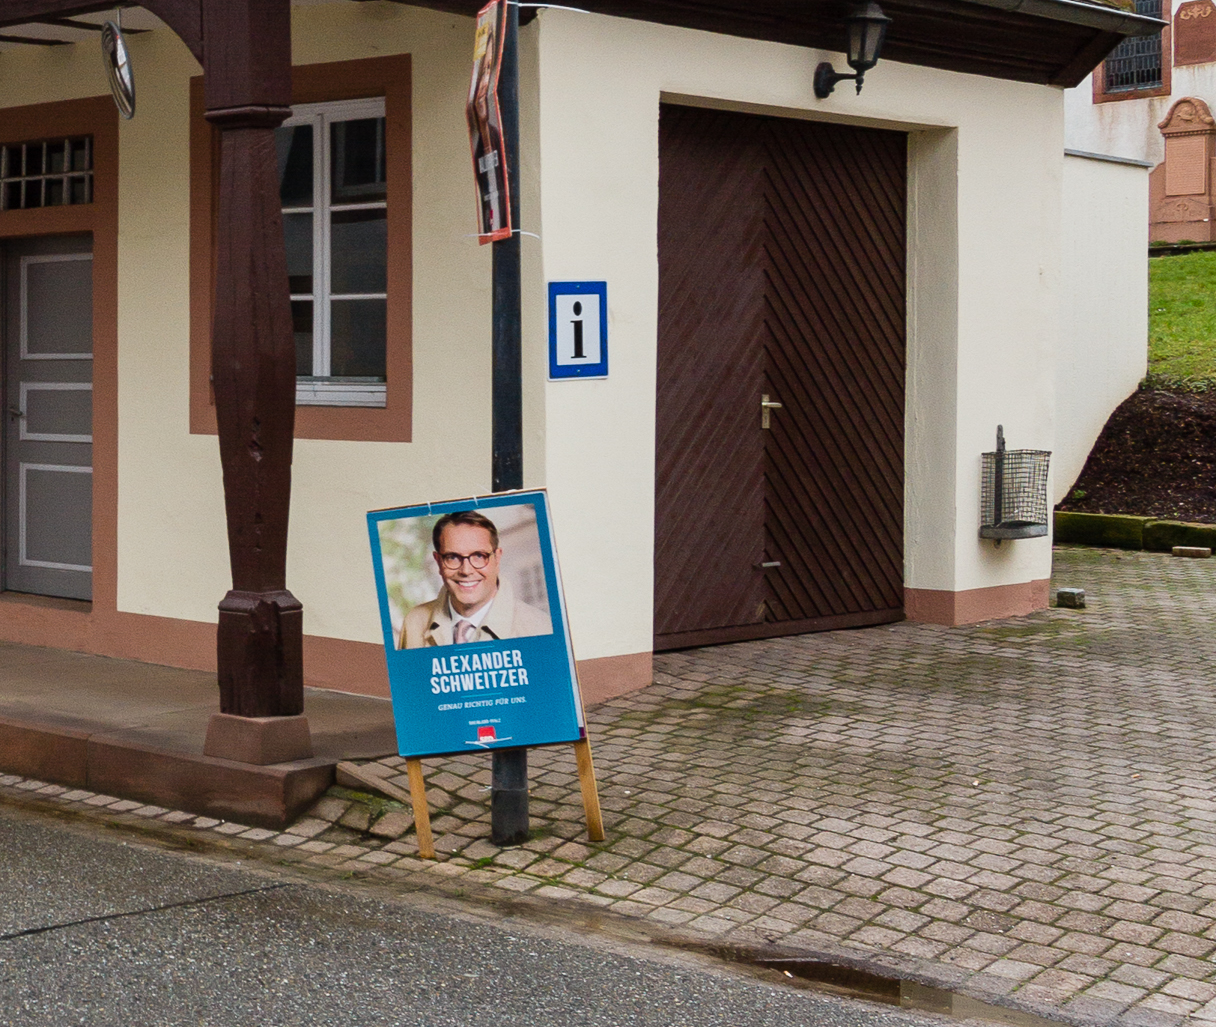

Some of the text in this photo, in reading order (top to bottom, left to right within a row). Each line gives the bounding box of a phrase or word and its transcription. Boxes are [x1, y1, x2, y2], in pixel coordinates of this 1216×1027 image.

[570, 300, 587, 359] i
[432, 649, 523, 676] ALEXANDER
[430, 668, 529, 694] SCHWEITZER
[438, 696, 527, 711] GENAU RICHTIG FÜR UNS.
